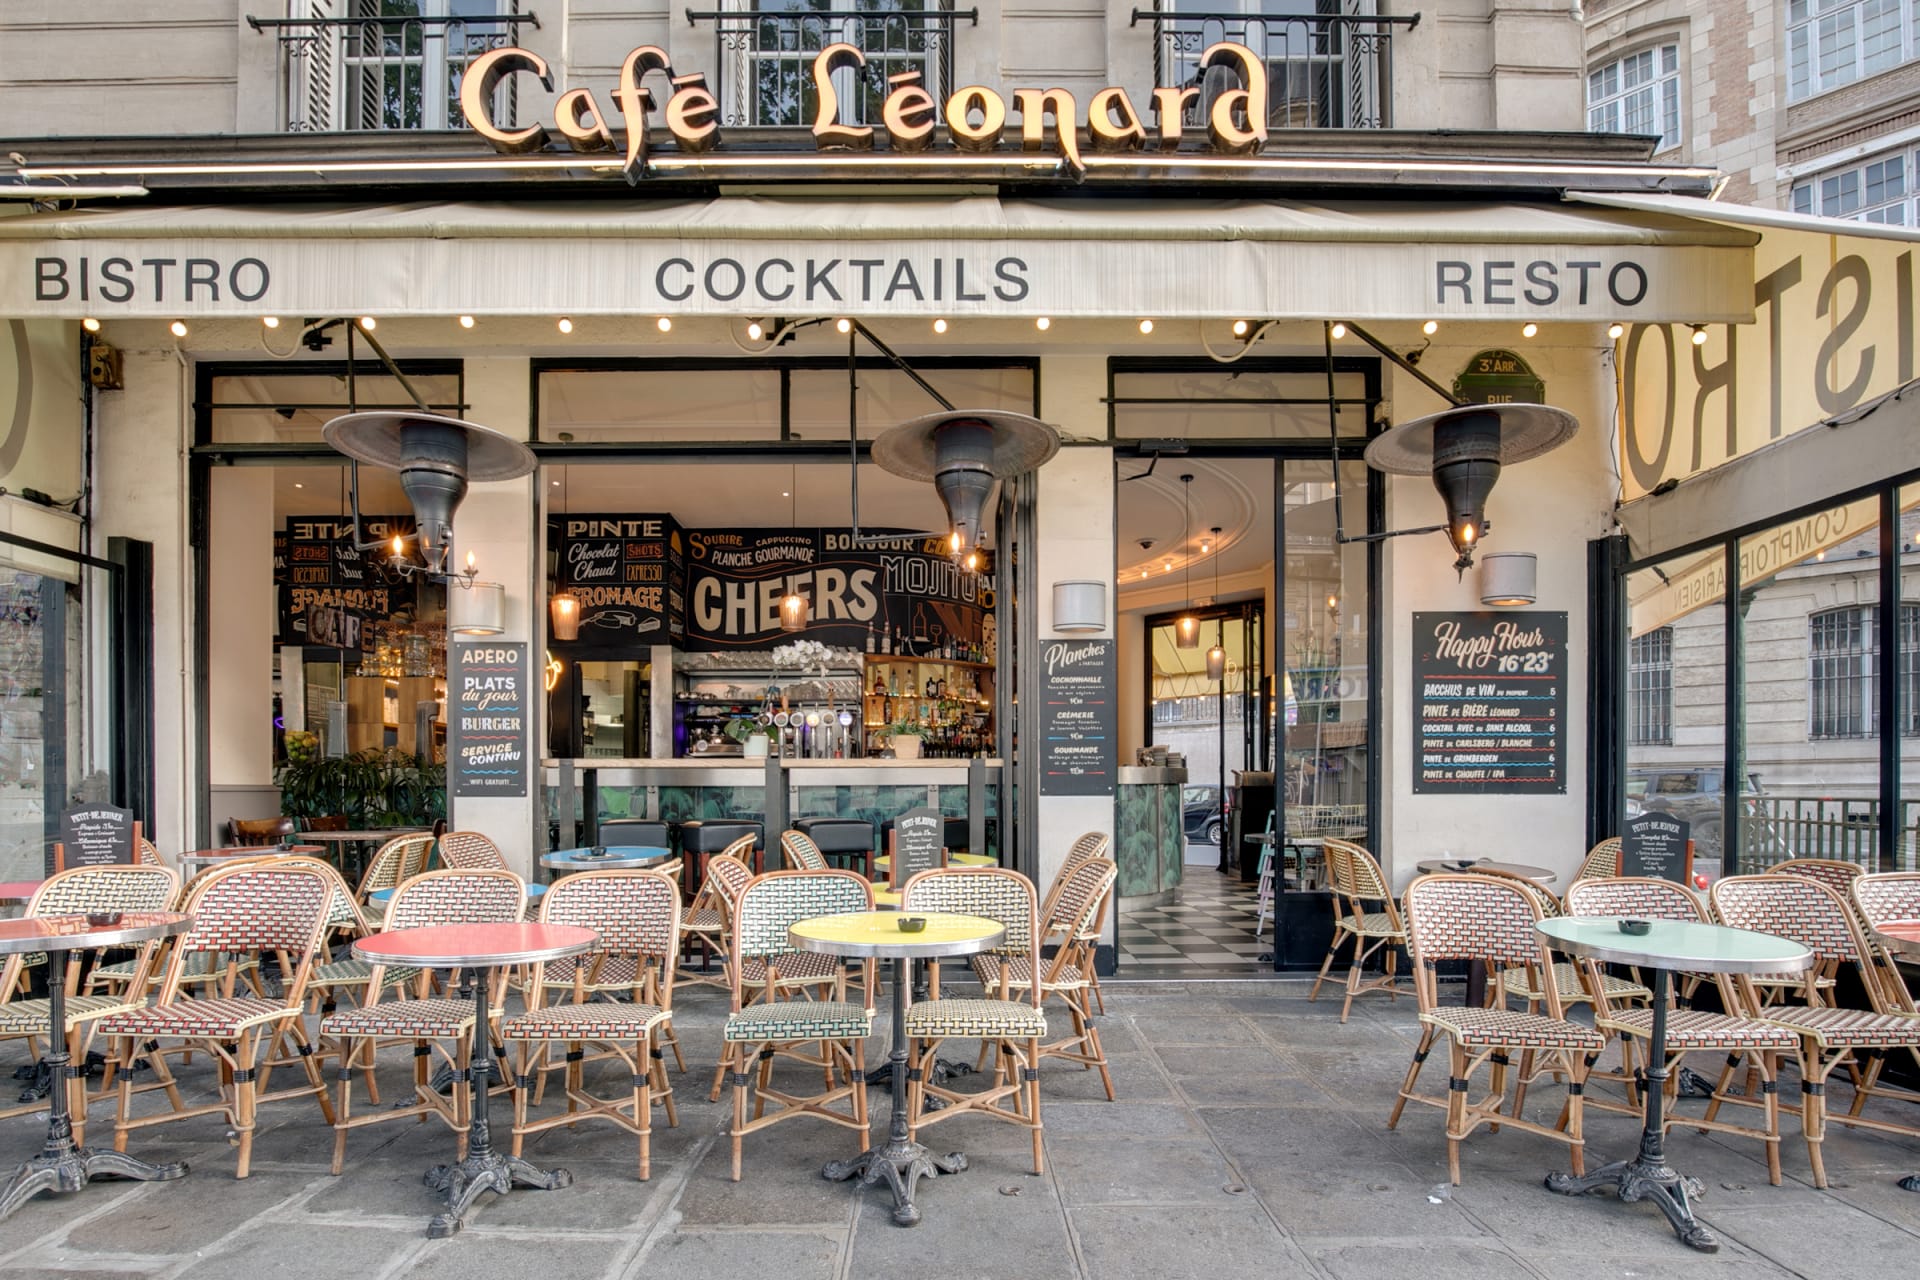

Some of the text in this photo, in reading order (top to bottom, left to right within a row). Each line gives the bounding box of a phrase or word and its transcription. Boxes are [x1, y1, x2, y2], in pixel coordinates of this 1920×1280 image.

[461, 42, 1269, 186] Café Léonard
[35, 257, 271, 301] BISTRO
[655, 257, 1030, 302] COCKTAILS
[1436, 260, 1648, 305] RESTO
[567, 520, 663, 537] PINTE
[755, 536, 812, 547] CAPPUCCINO
[825, 534, 914, 550] BONJOUR
[568, 543, 619, 563] Chocolat
[627, 543, 663, 558] SHOTS
[712, 546, 815, 567] PLANCHE GOURMANDE
[574, 560, 616, 581] Chaud
[626, 564, 662, 581] EXPRESSO
[880, 555, 975, 602] MOJITO
[567, 586, 664, 613] FROMAGE
[694, 568, 877, 635] CHEERS
[1434, 621, 1544, 670] Happy Hour
[462, 648, 518, 664] APÉRO
[1044, 642, 1105, 675] Planches
[464, 677, 516, 691] PLATS
[1424, 684, 1462, 696] BACCHUS
[1466, 687, 1476, 696] DE
[1478, 684, 1496, 696] VIN
[462, 688, 518, 711] du jour
[1423, 705, 1449, 717] PINTE
[1451, 708, 1460, 717] DE
[1462, 703, 1488, 717] BIÈRE
[1549, 708, 1556, 717] 5
[462, 717, 520, 731] BURGER
[1422, 724, 1454, 732] COCKTAIL
[1456, 724, 1474, 732] AVEC
[1485, 724, 1504, 732] SANS
[1505, 724, 1532, 732] ALCOOL
[1549, 724, 1555, 732] 6
[461, 743, 512, 757] SERVICE
[1054, 746, 1098, 754] GOURMANDE
[1423, 739, 1444, 748] PINTE
[1455, 739, 1495, 748] CARLSBERG
[1501, 739, 1533, 748] BLANCHE
[1549, 739, 1555, 748] 6
[469, 751, 521, 765] CONTINU
[1423, 755, 1442, 763] PINTE
[1453, 754, 1498, 763] GRIMBERGEN
[1549, 754, 1555, 762] 6
[1423, 770, 1443, 778] PINTE
[1455, 770, 1485, 778] CHOUFFE
[1493, 770, 1505, 778] IPA
[1549, 770, 1555, 778] 7
